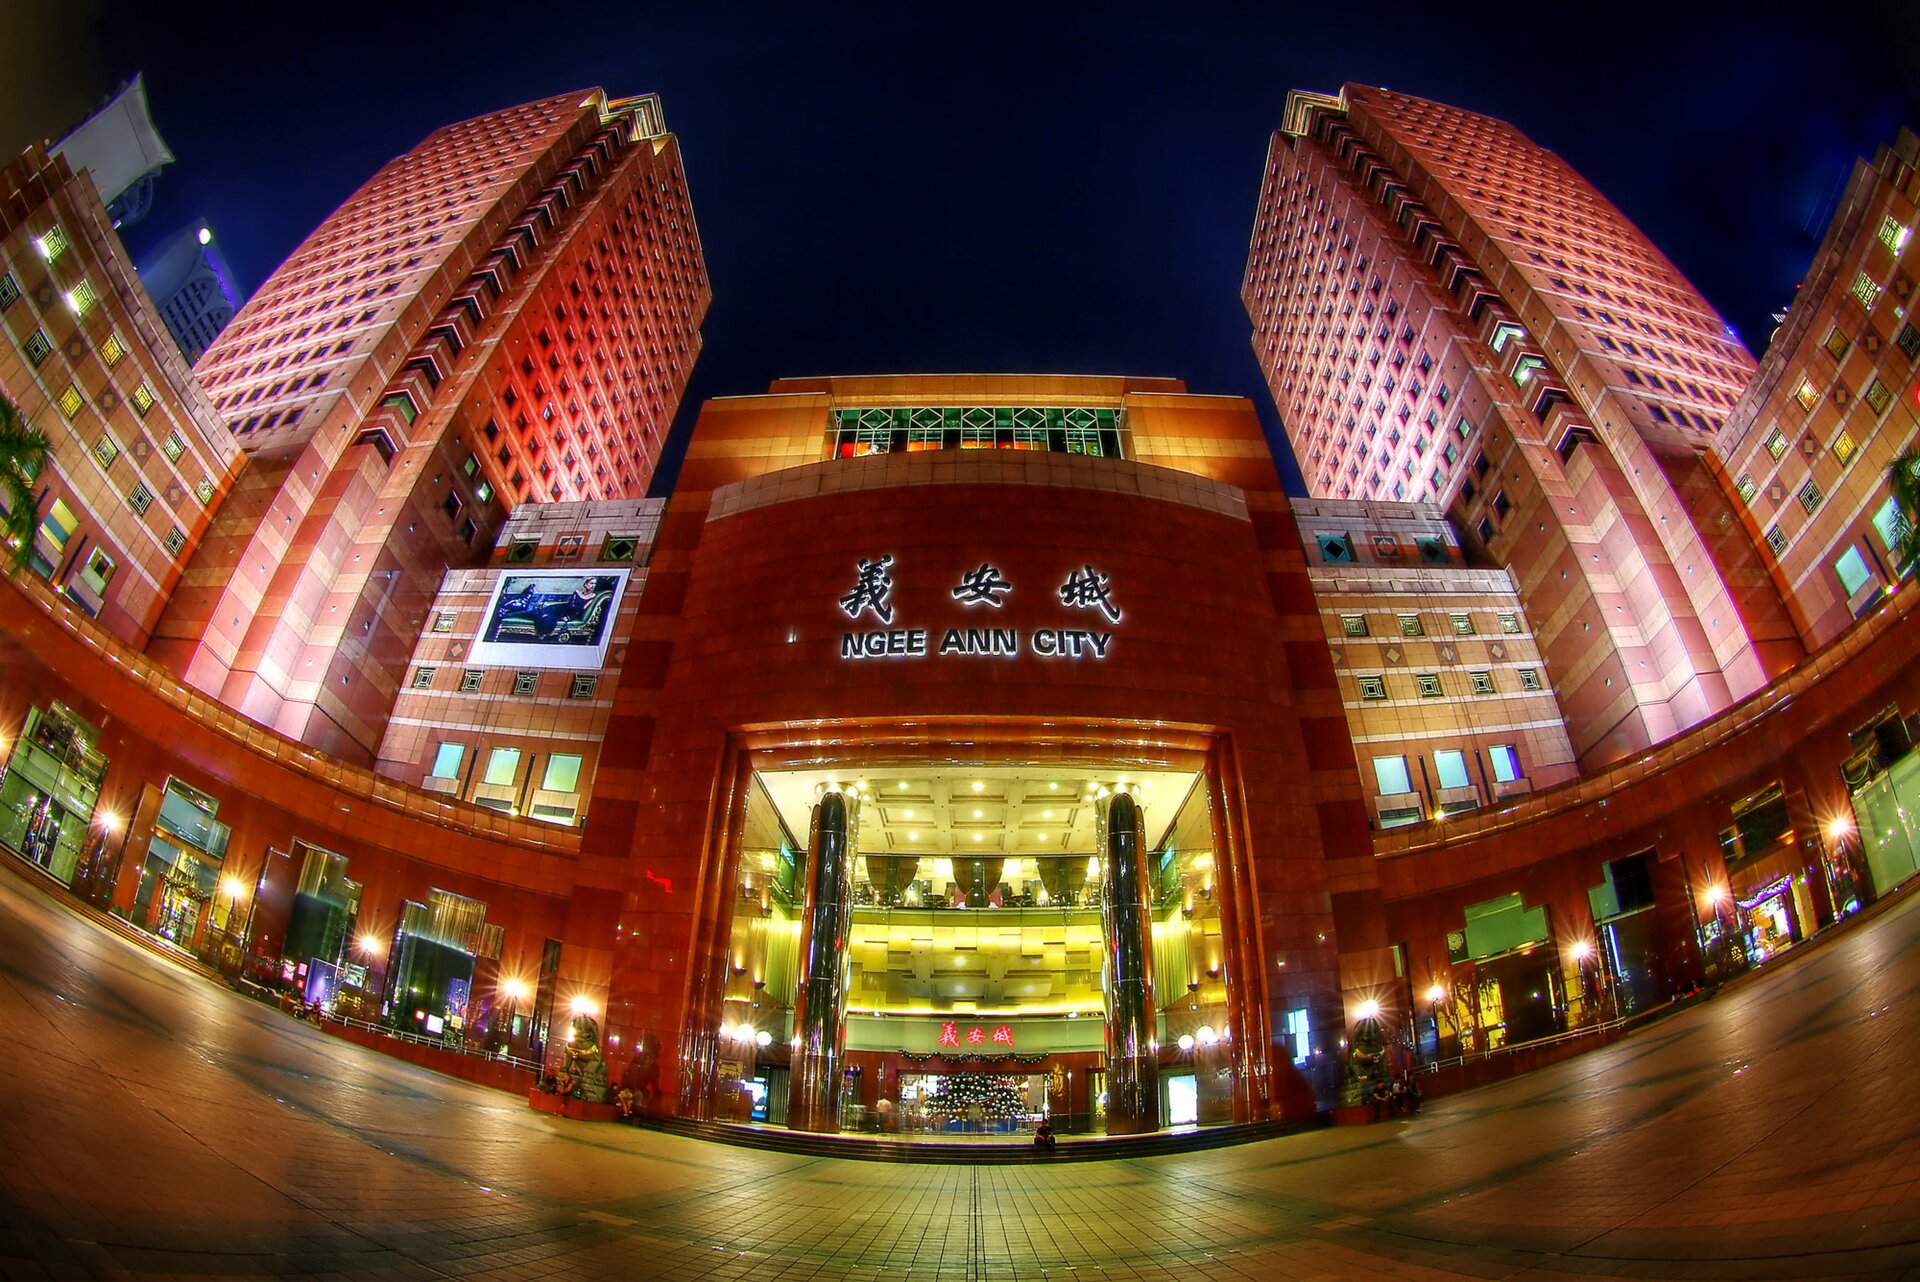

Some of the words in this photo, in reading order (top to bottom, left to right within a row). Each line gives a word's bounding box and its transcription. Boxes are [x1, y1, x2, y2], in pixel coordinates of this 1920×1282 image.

[839, 554, 1122, 625] 義安城
[841, 630, 925, 658] NGEE
[940, 627, 1018, 657] ANN
[1032, 629, 1112, 659] CITY
